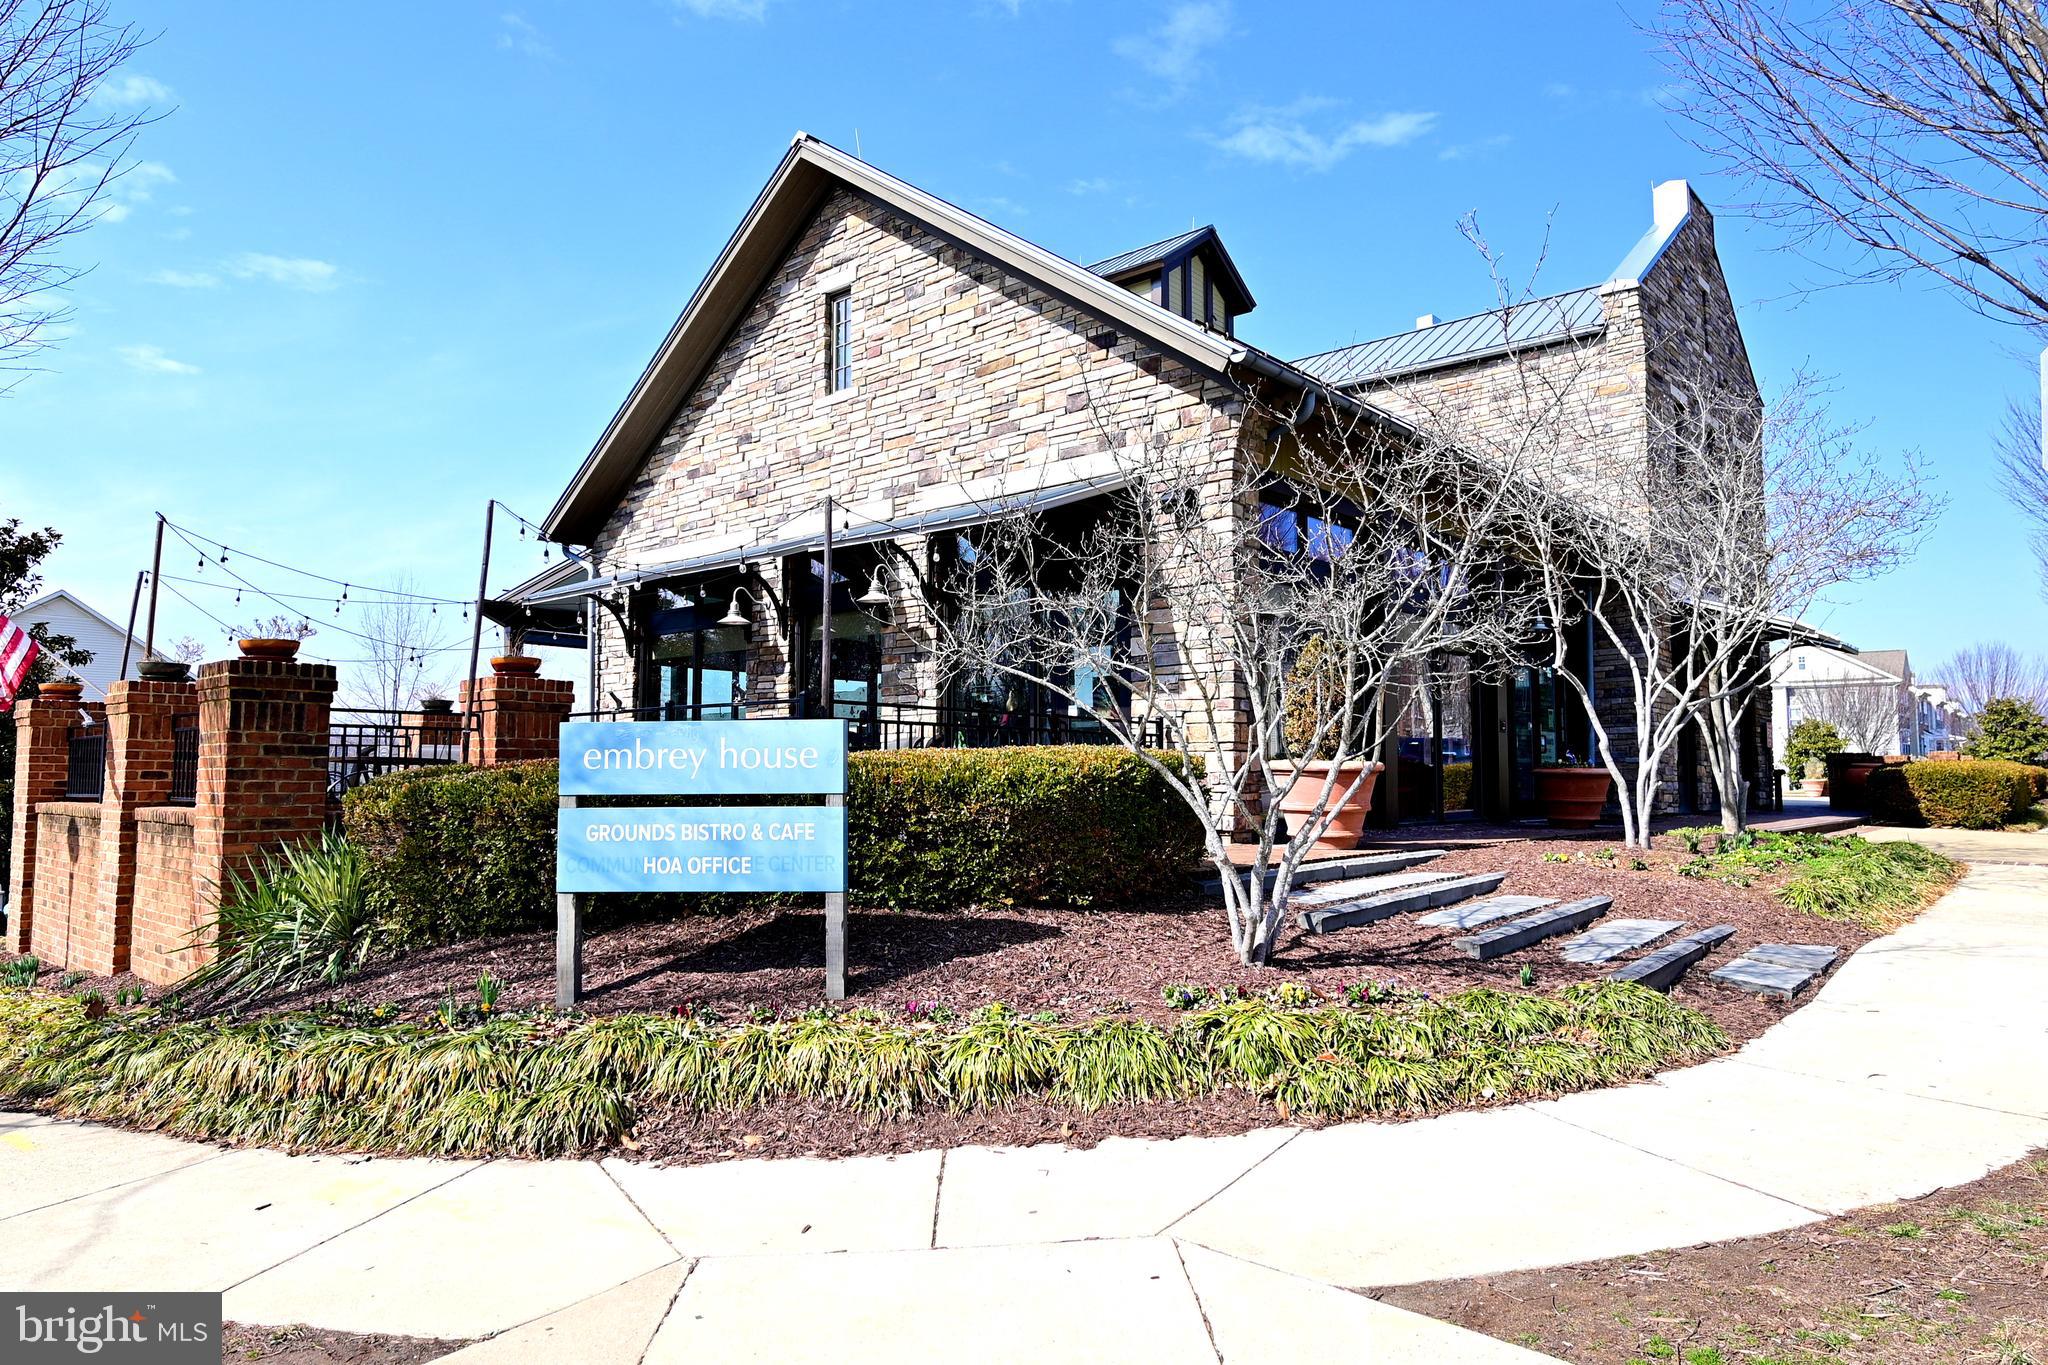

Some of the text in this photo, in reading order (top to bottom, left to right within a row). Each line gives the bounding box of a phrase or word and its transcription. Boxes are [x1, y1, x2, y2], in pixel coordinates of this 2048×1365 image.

[583, 737, 818, 779] embrey house
[586, 823, 815, 842] GROUNDS BISTRO & CAFE
[643, 857, 683, 874] HOA
[687, 856, 752, 874] OFFICE
